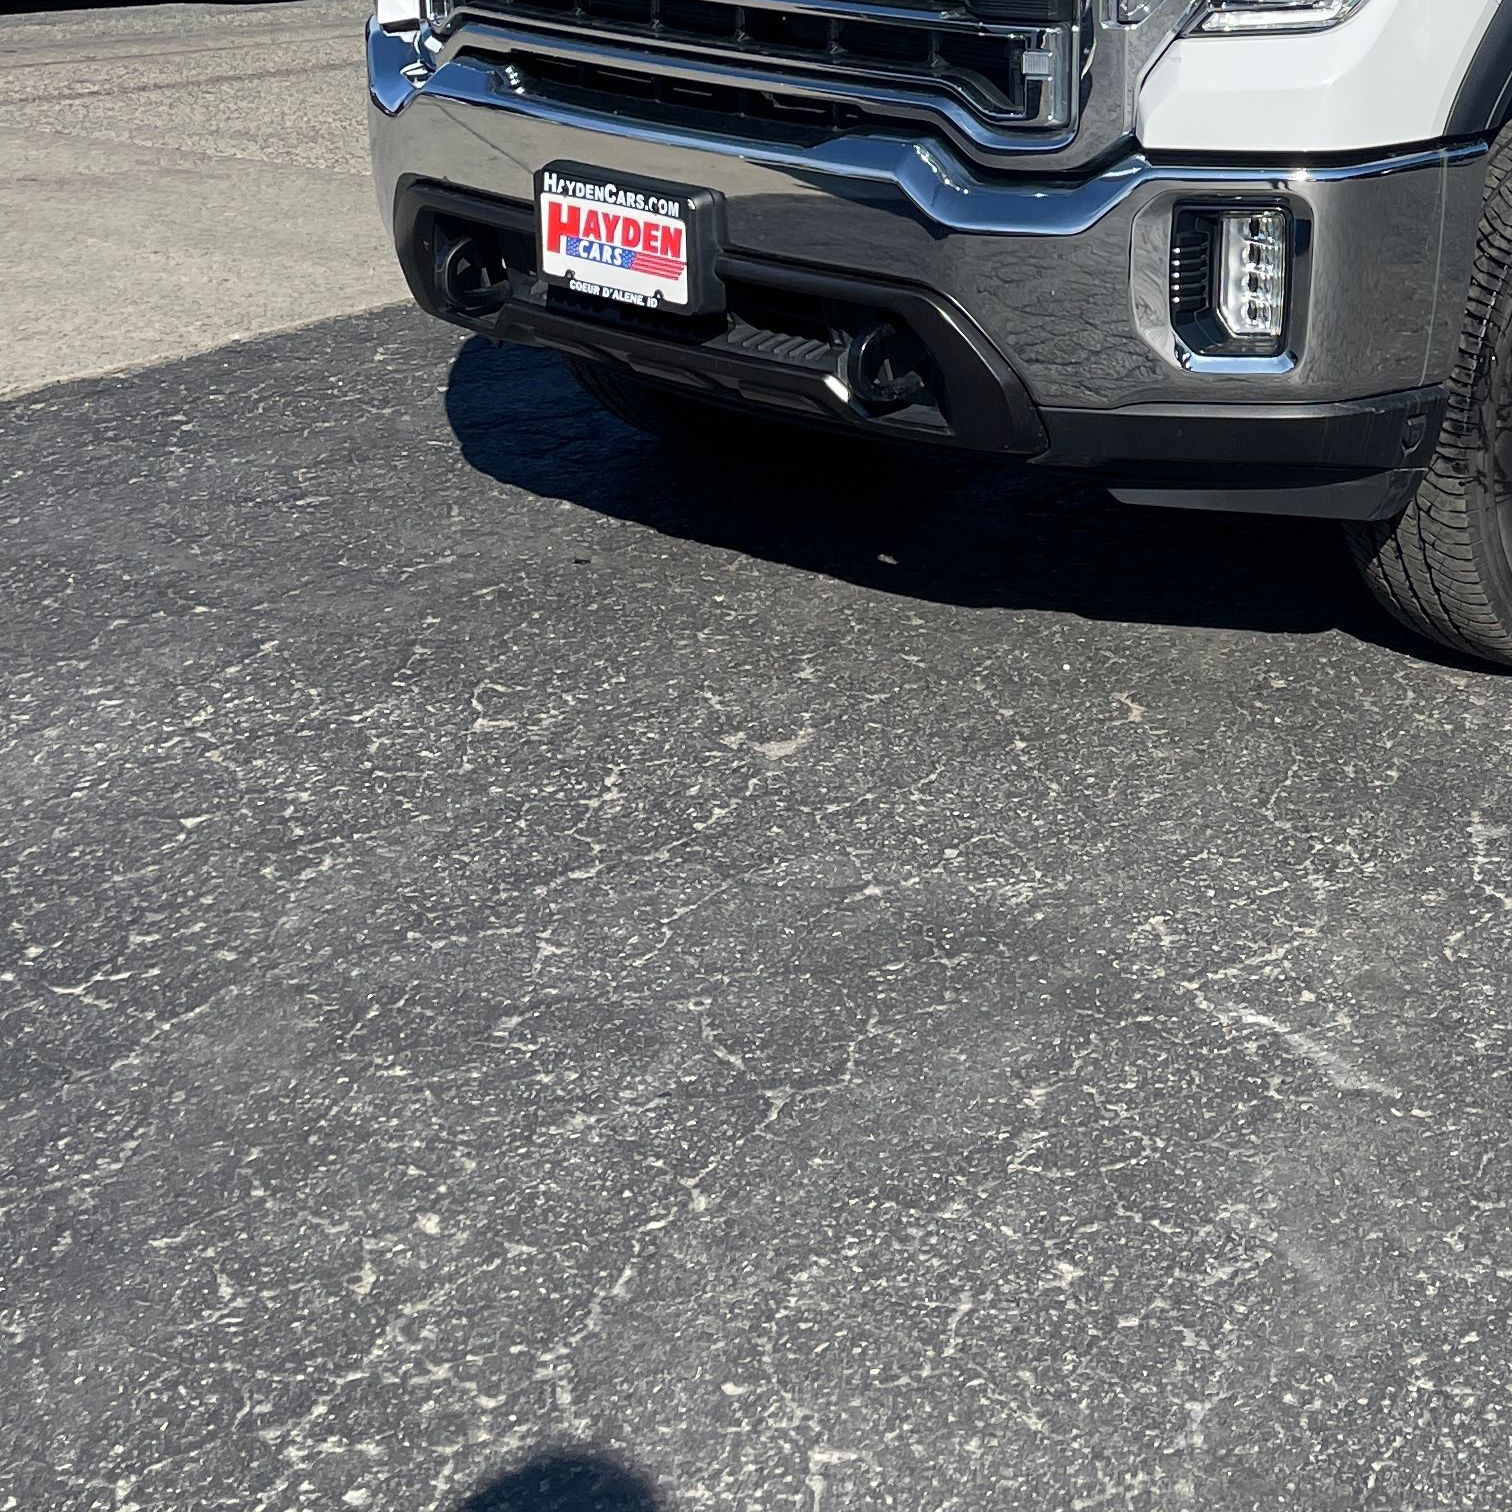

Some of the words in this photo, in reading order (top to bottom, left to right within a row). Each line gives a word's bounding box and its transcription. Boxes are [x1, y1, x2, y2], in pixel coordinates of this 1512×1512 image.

[547, 201, 683, 258] HAYDEN
[578, 240, 623, 266] CARS
[569, 279, 600, 296] COEUR
